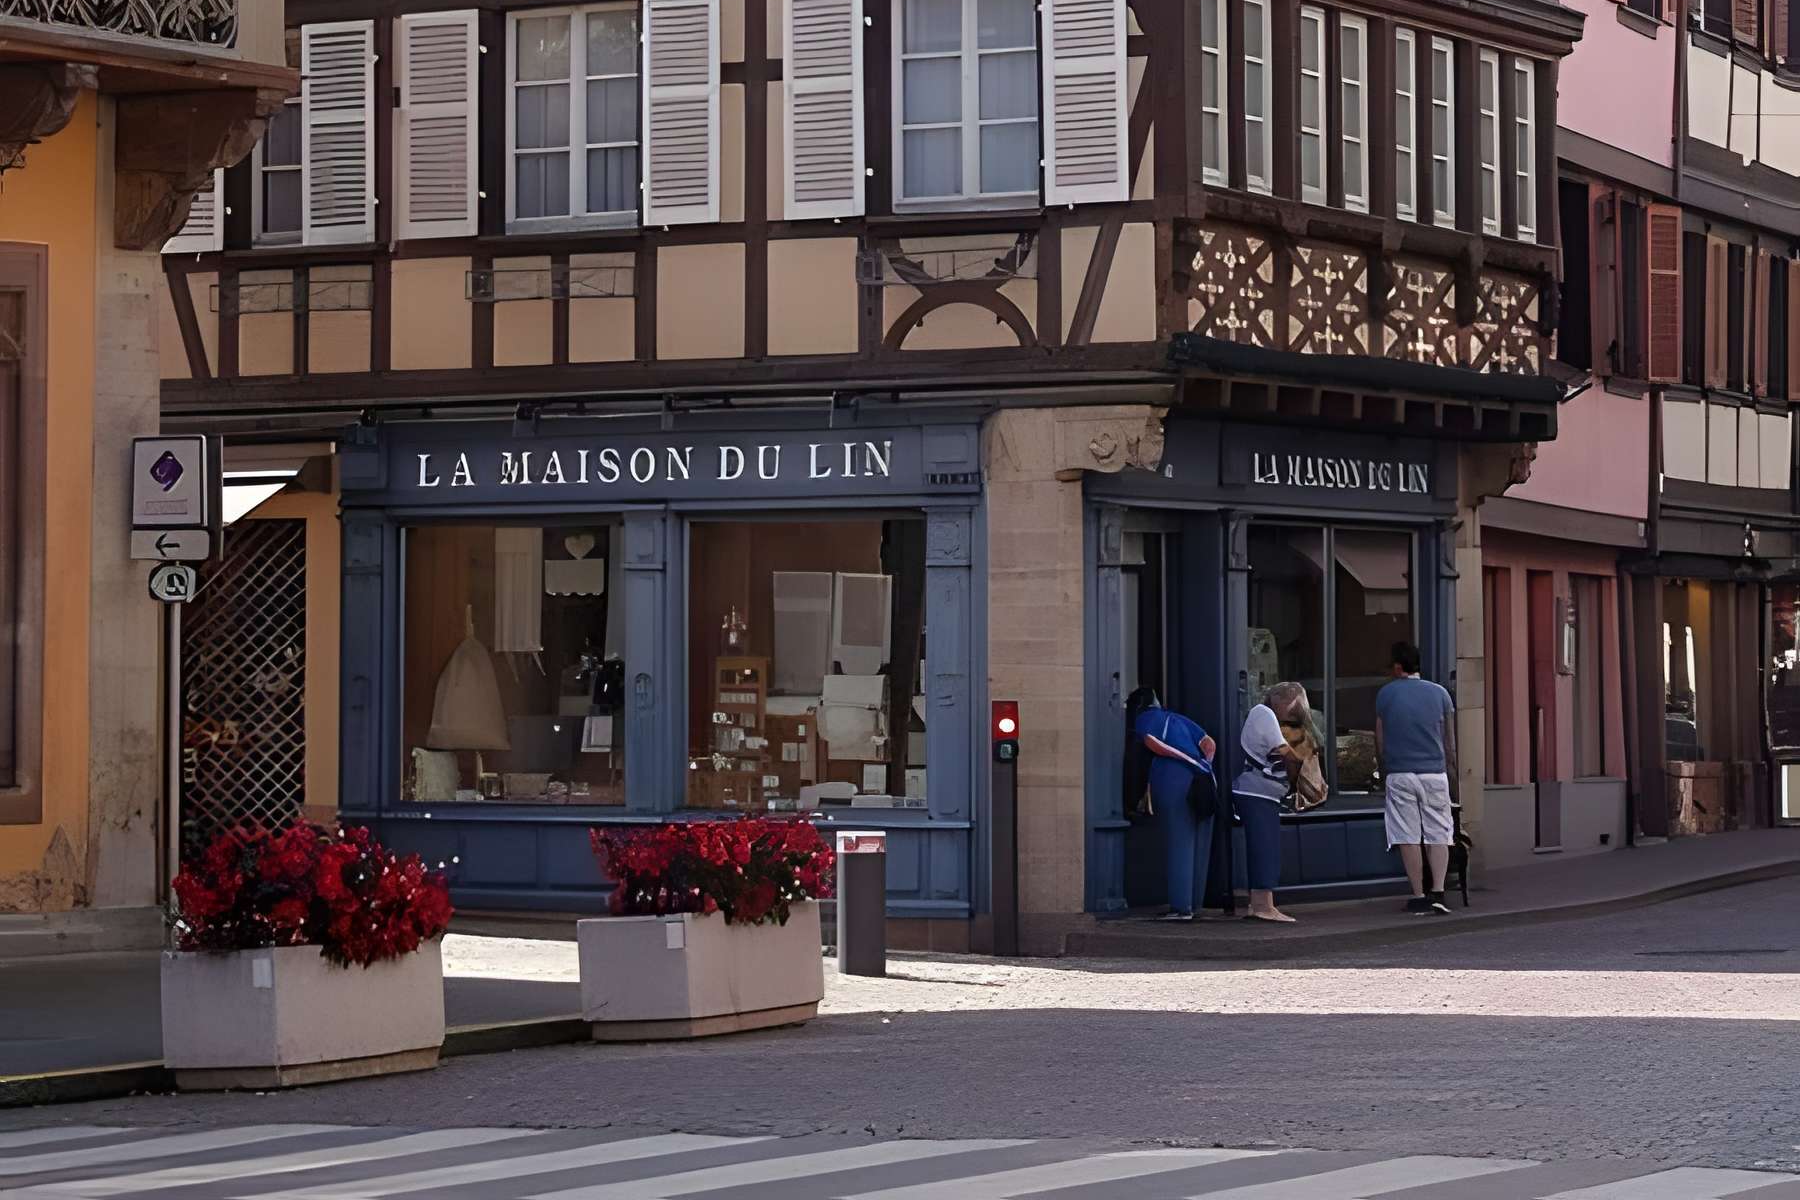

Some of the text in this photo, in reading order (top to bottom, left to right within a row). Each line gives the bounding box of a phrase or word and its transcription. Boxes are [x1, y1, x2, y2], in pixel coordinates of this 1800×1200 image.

[417, 440, 892, 487] LA MAISON DU LIN
